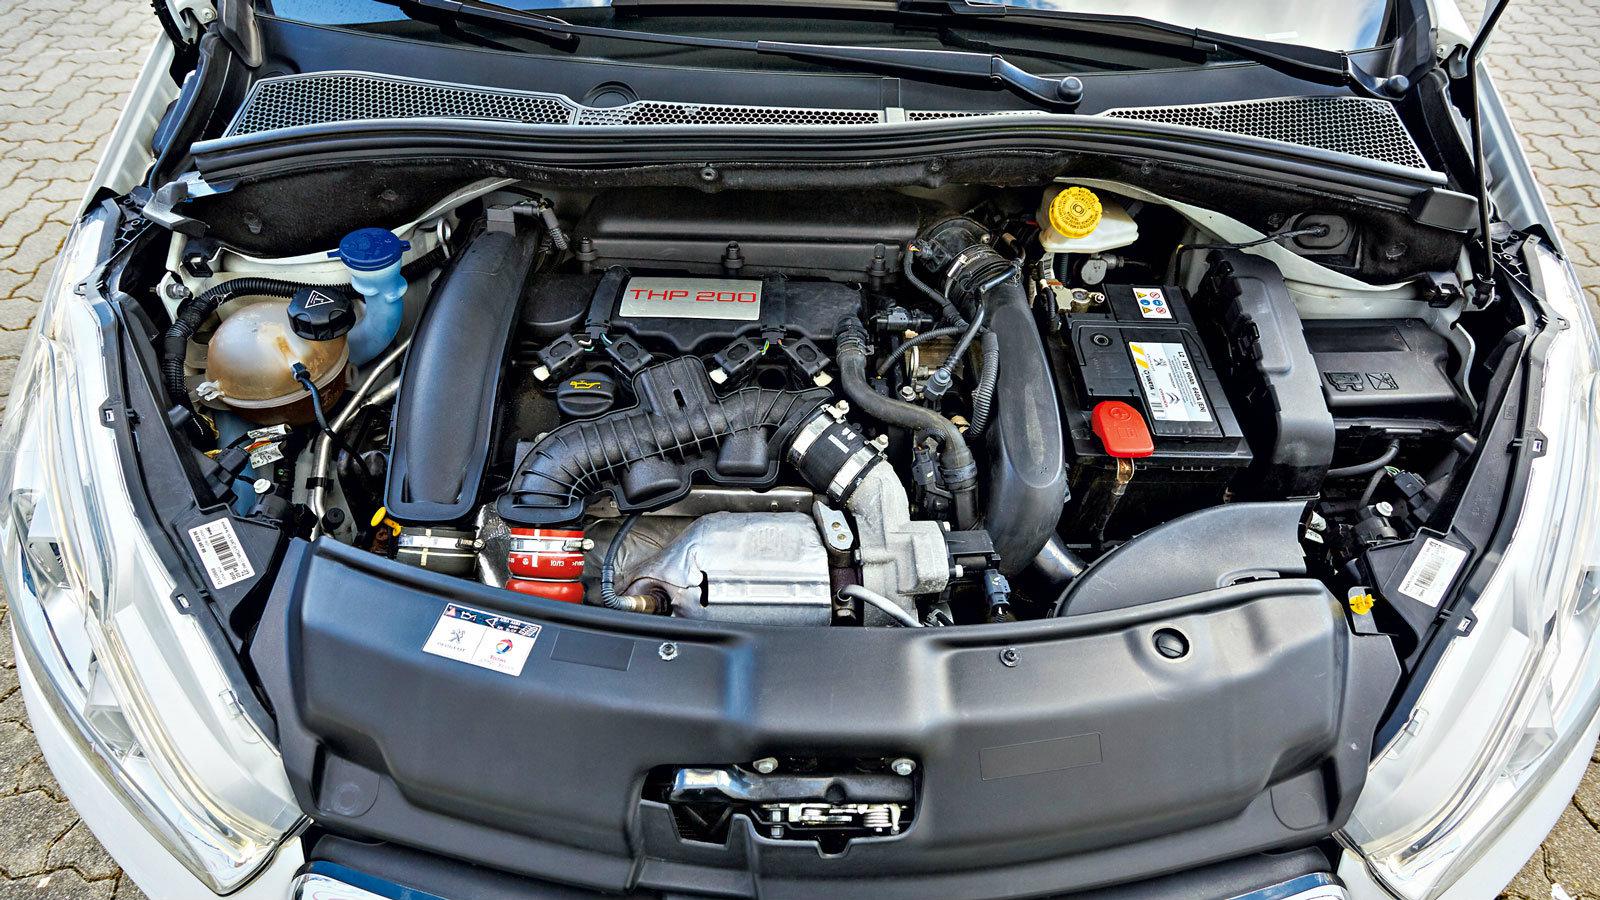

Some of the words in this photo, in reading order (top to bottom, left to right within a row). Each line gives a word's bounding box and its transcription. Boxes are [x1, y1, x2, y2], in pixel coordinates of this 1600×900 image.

[630, 289, 689, 301] THP
[696, 291, 757, 303] 200
[1146, 375, 1155, 391] VARTA
[1181, 360, 1190, 370] 12V
[1197, 401, 1207, 413] (EN)
